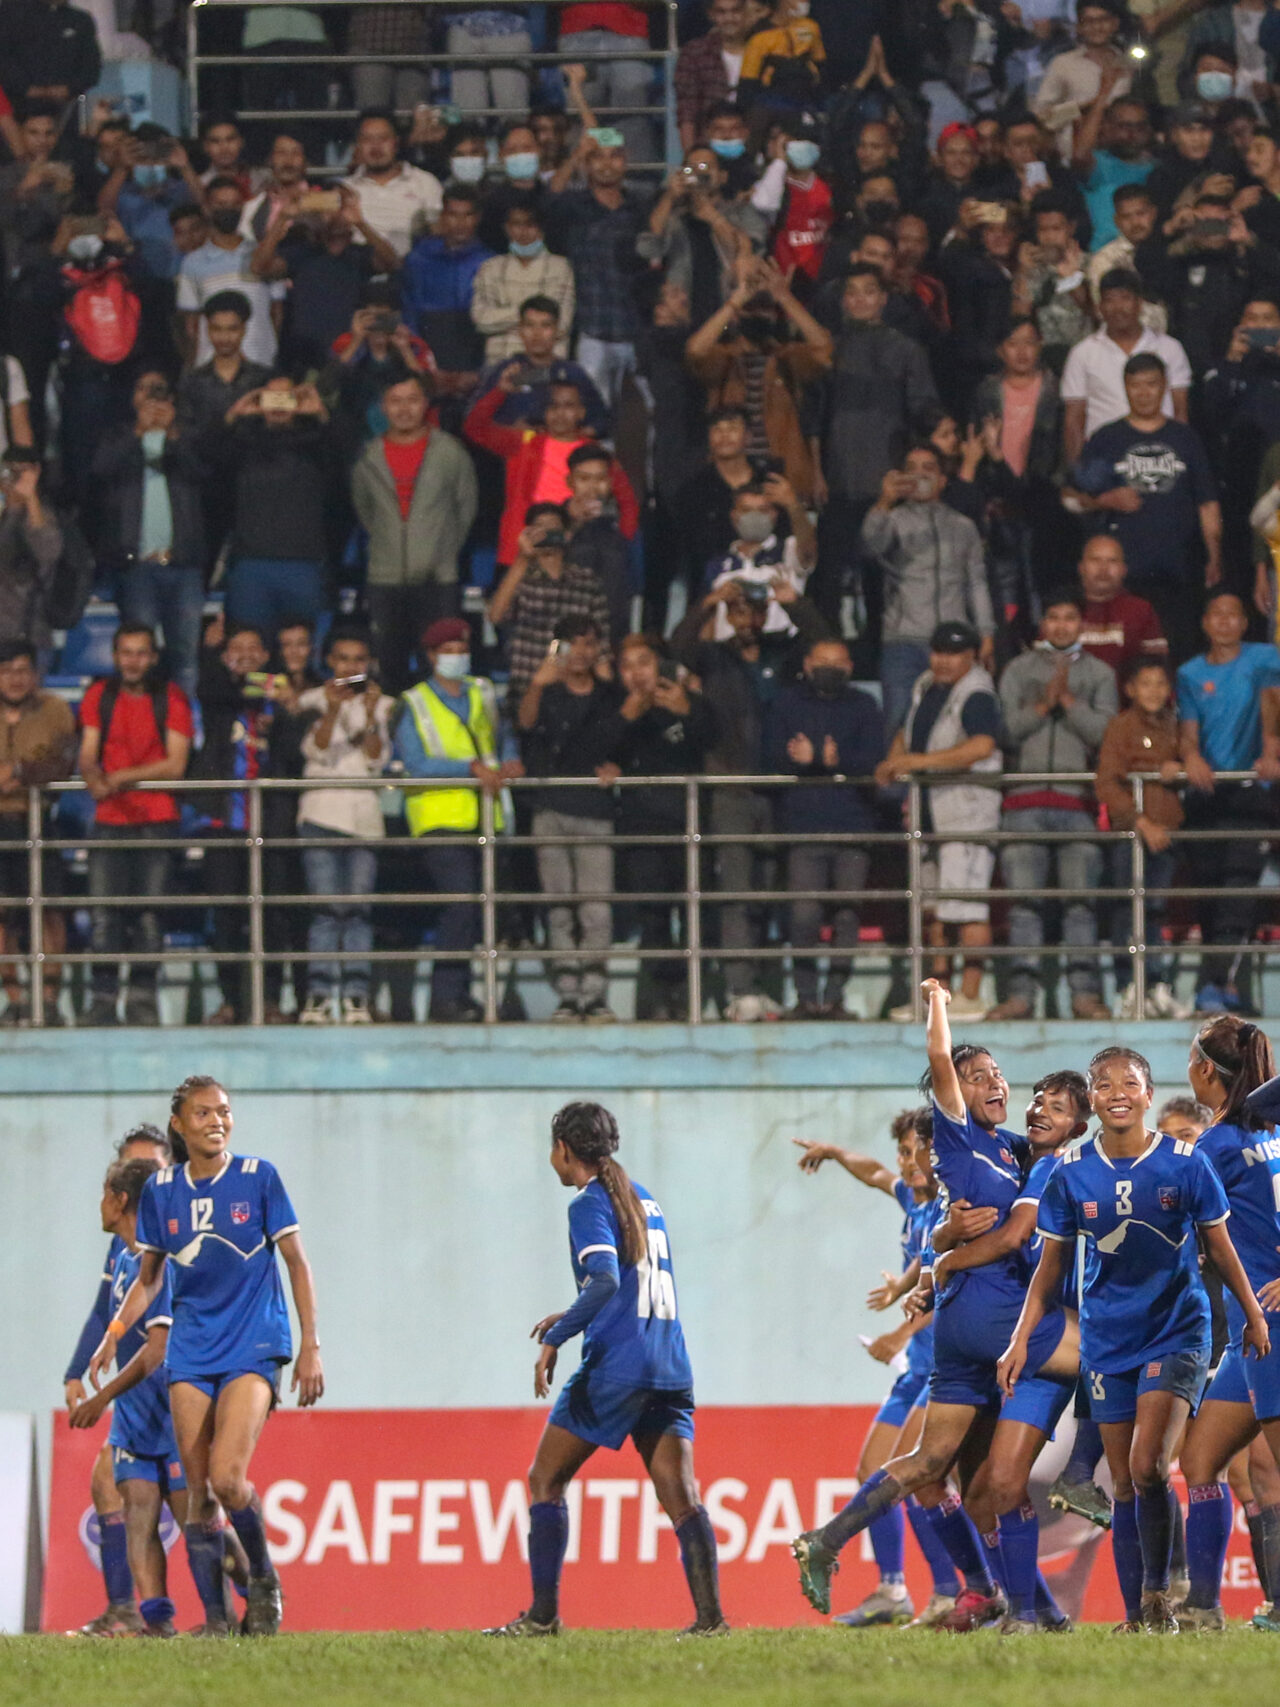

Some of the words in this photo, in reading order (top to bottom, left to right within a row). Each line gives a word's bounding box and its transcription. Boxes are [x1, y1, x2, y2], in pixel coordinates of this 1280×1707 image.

[189, 1197, 214, 1232] 12
[1115, 1180, 1134, 1216] 3
[1090, 1371, 1106, 1401] 3
